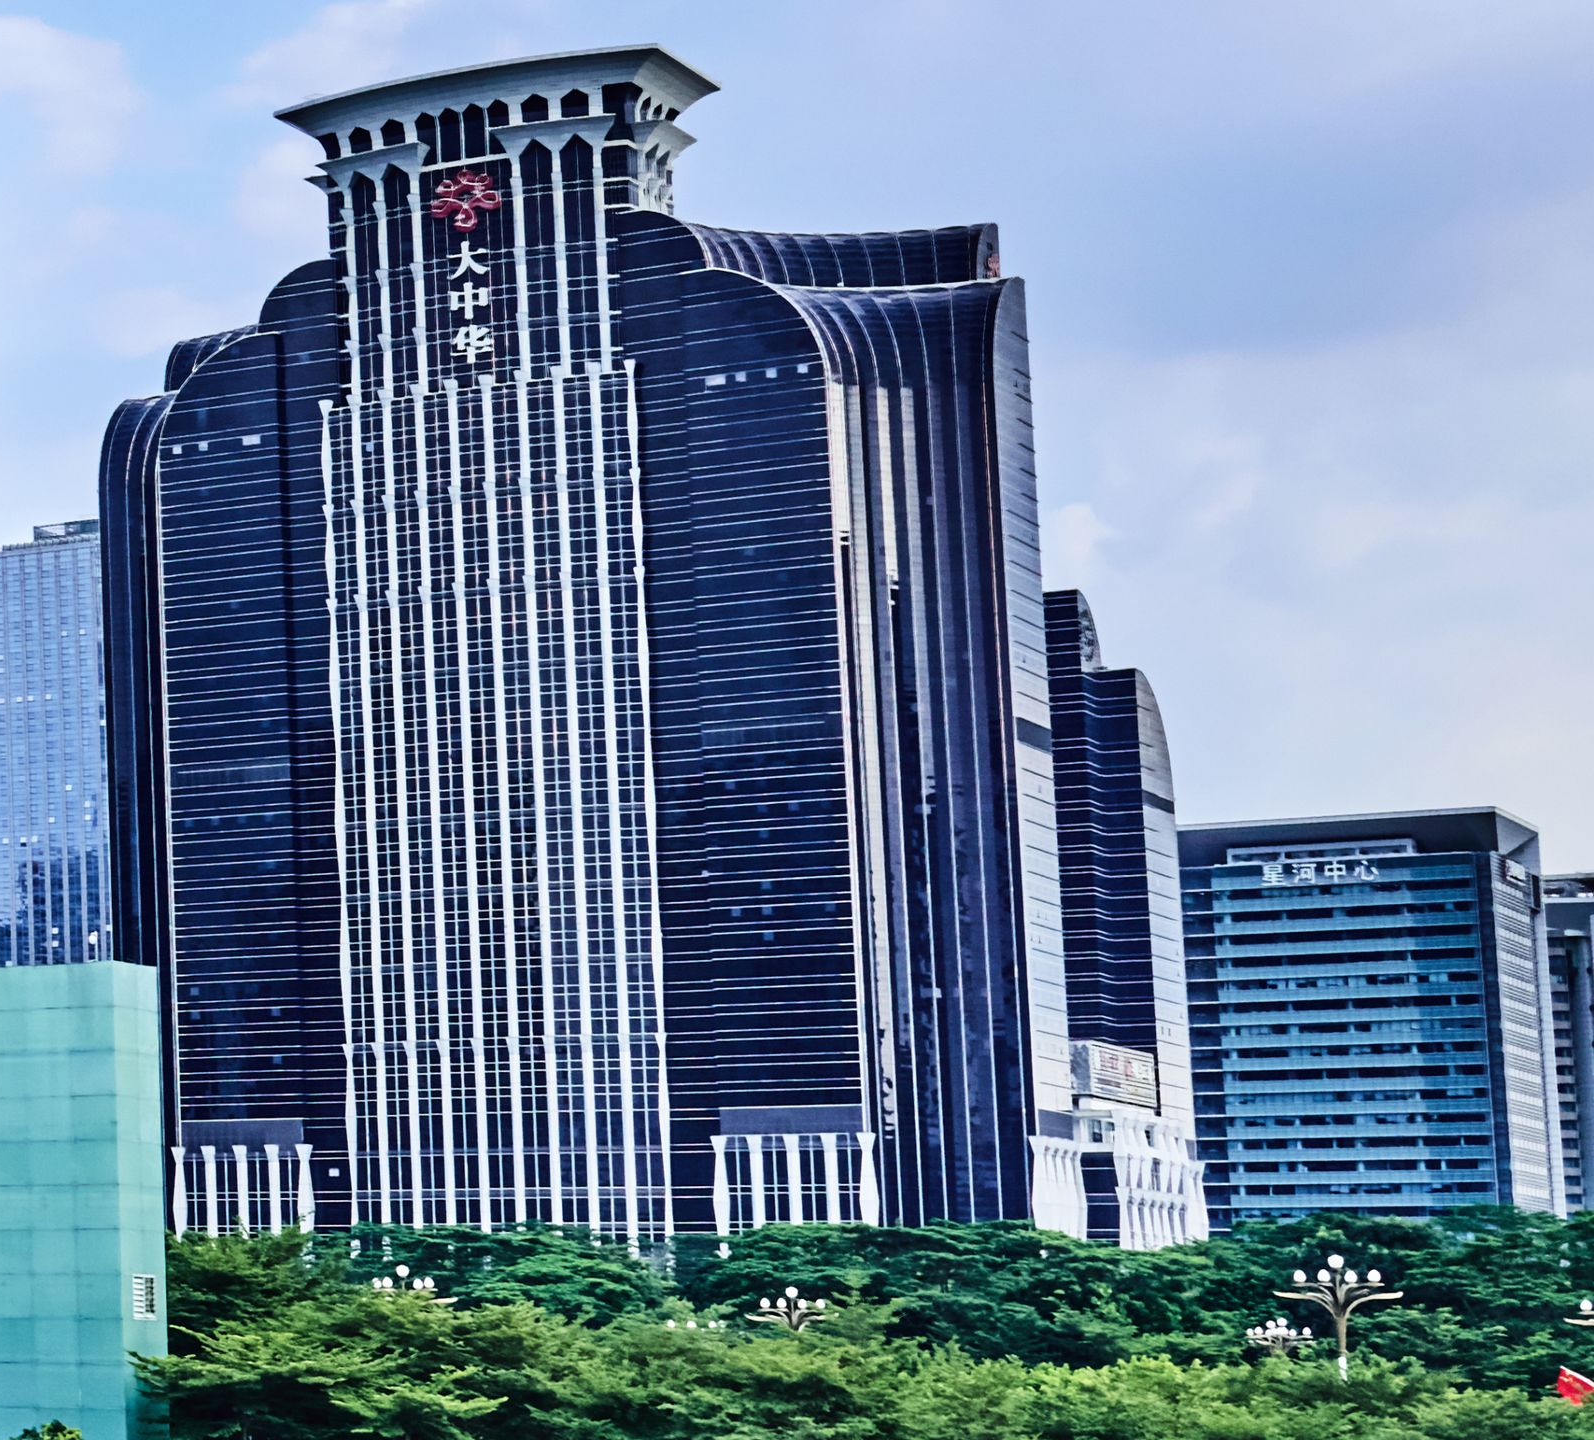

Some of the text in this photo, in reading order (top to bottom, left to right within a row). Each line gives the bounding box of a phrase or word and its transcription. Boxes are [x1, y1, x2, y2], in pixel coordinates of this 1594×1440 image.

[446, 241, 494, 364] 大中华
[1261, 860, 1379, 886] 星河中心
